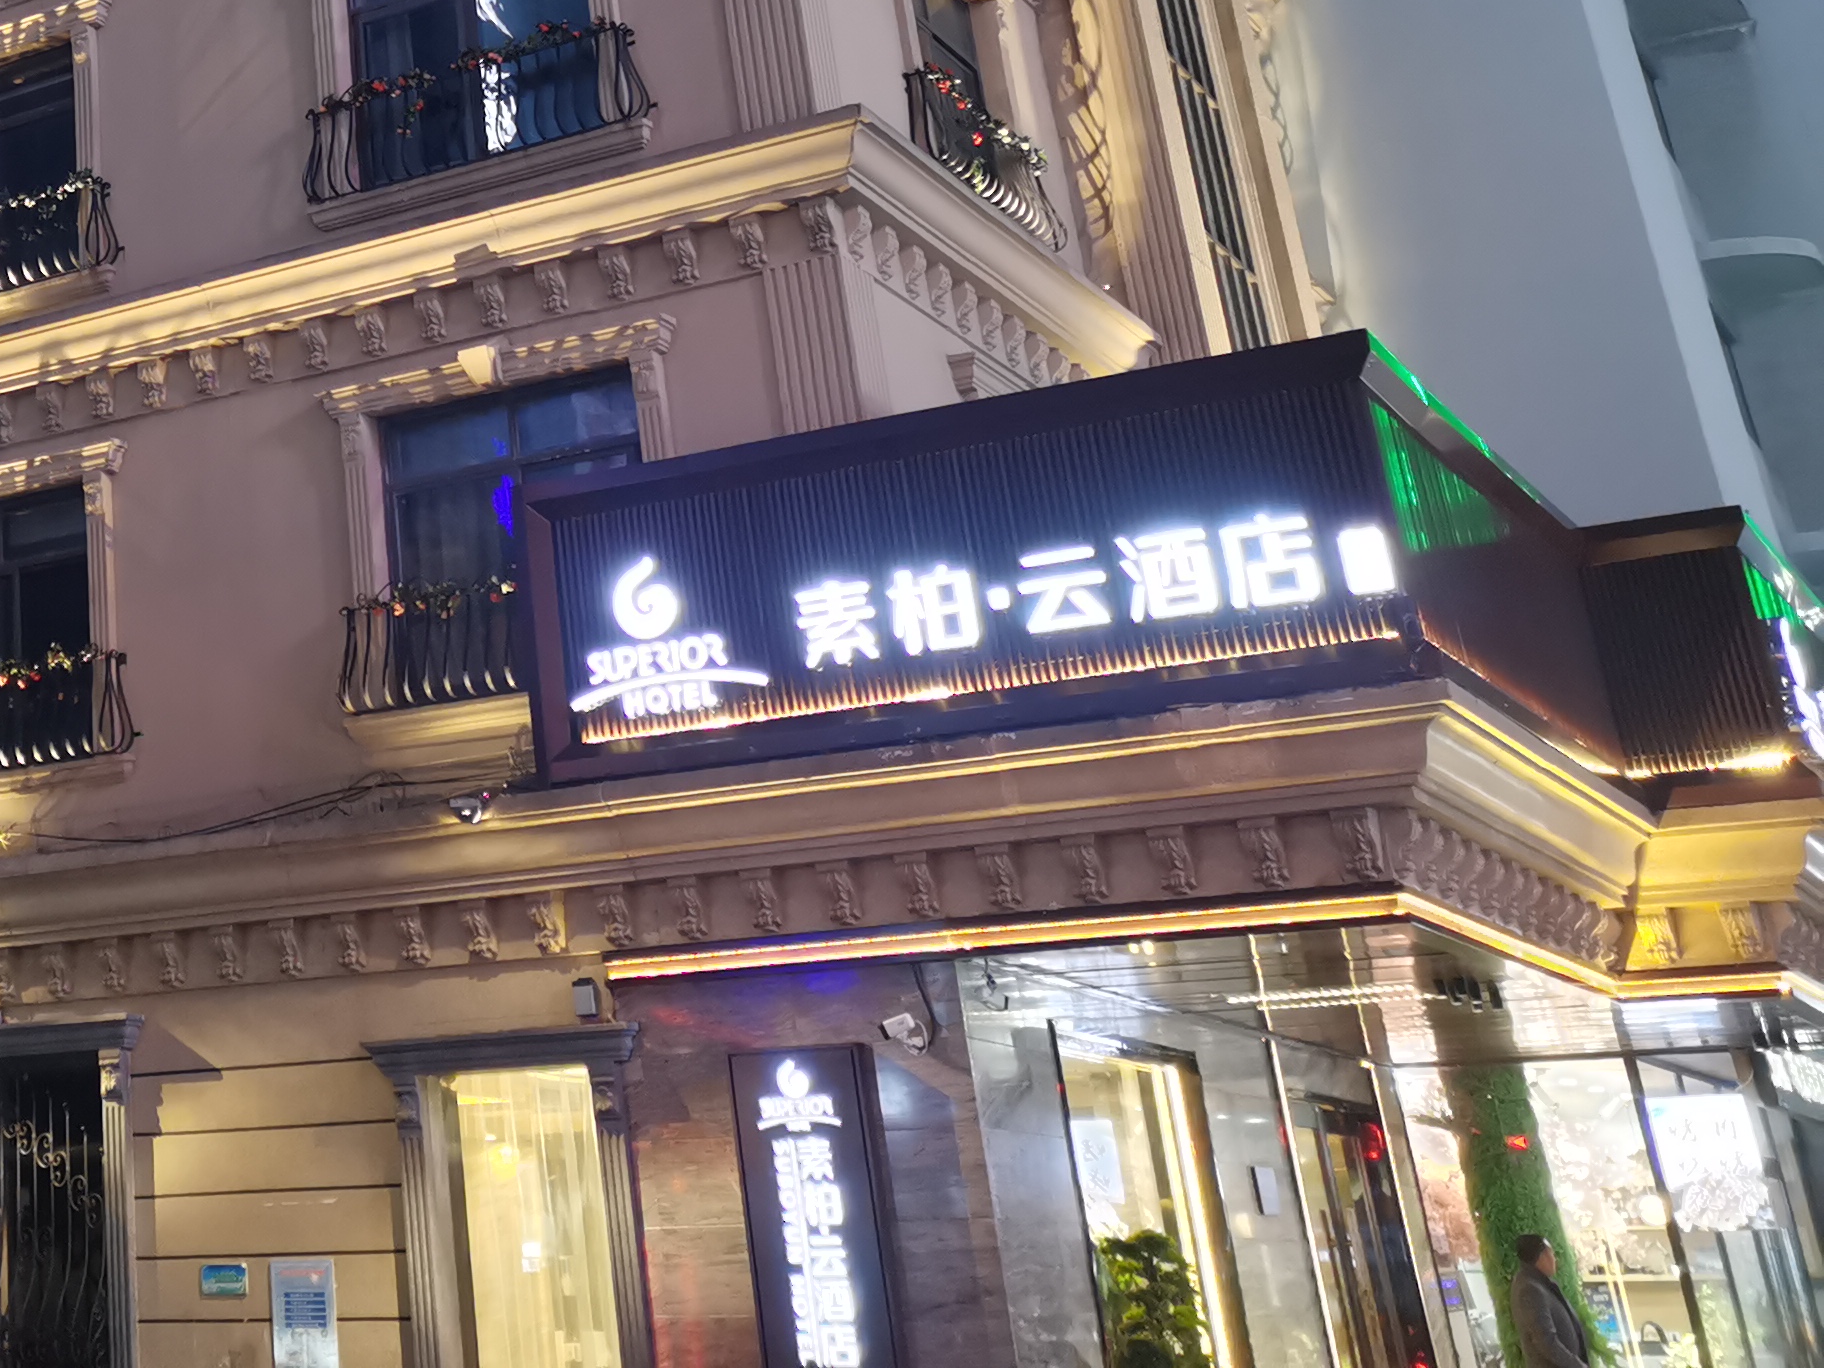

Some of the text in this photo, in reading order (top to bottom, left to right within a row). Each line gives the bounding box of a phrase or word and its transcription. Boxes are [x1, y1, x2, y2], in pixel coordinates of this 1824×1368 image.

[587, 634, 728, 685] SUPERIOR
[622, 680, 718, 720] HOTEL
[758, 1093, 834, 1120] SUPERIOR
